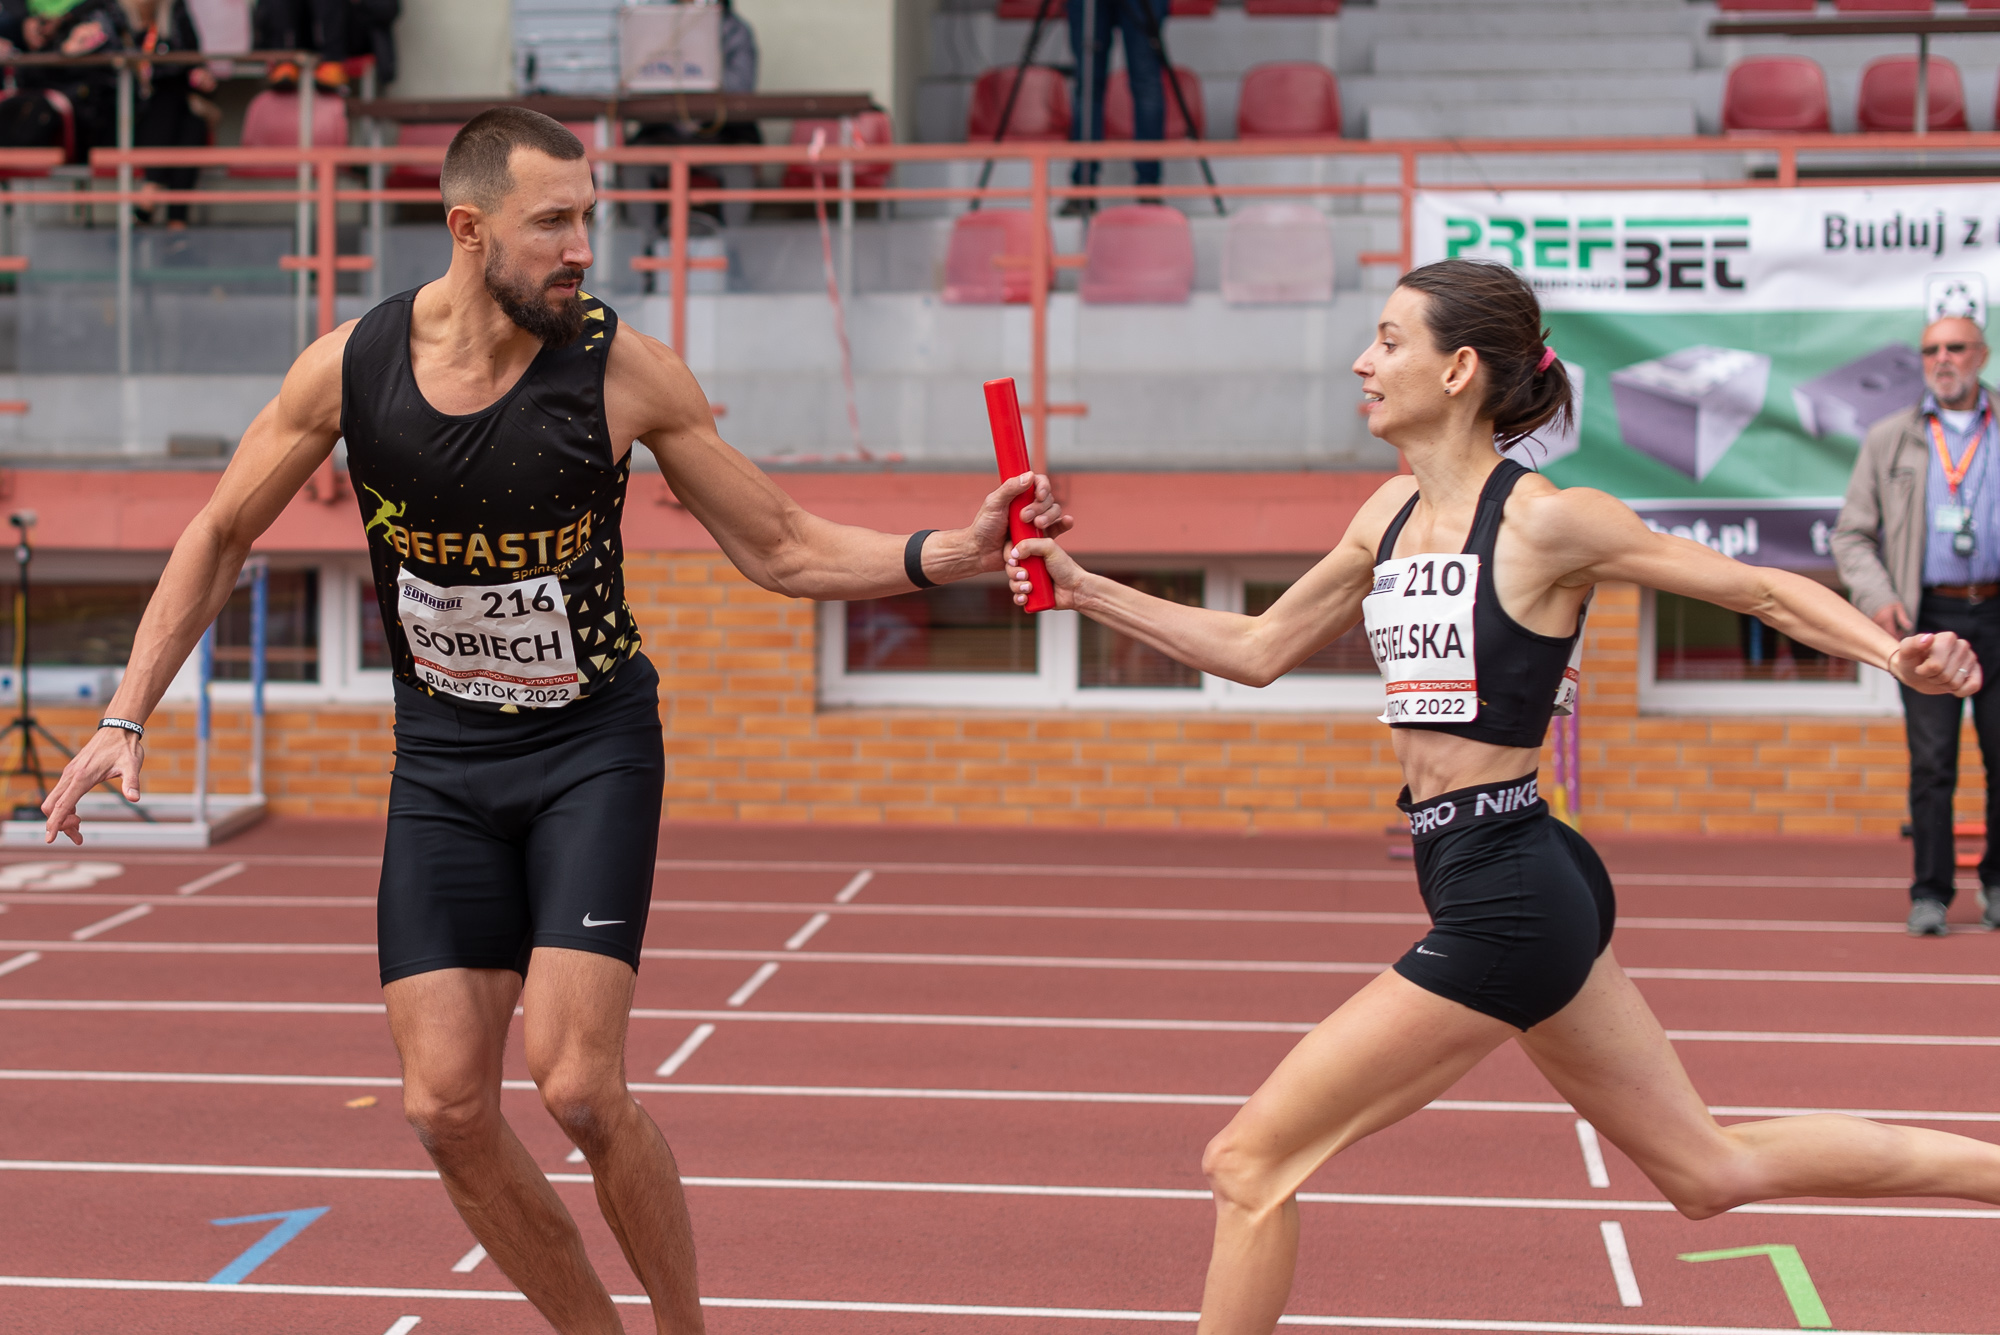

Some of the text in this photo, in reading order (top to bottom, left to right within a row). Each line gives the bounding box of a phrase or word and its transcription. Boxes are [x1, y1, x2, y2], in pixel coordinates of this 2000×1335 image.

[1824, 209, 1945, 258] Buduj
[1961, 219, 1982, 246] z
[1403, 560, 1466, 597] 210
[480, 583, 555, 619] 216
[412, 625, 563, 664] SOBIECH
[425, 671, 571, 703] BIAŁYSTOK 2022
[525, 675, 574, 685] SZTAFETACH
[1419, 682, 1472, 690] SZTAFETACH
[1416, 698, 1465, 715] 2022
[1474, 778, 1539, 817] NIKE
